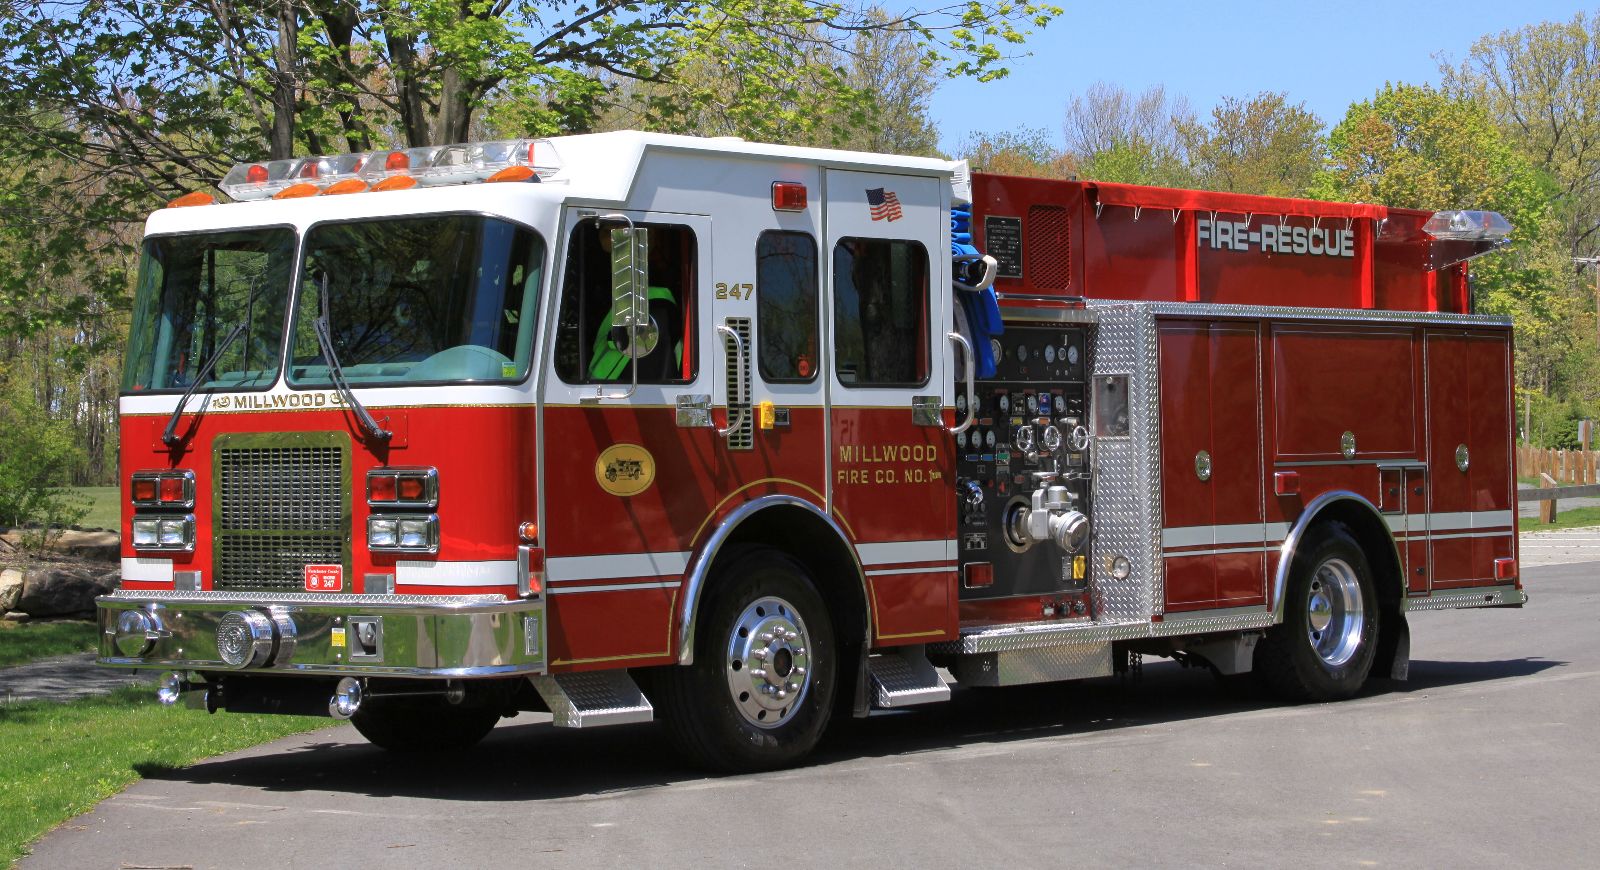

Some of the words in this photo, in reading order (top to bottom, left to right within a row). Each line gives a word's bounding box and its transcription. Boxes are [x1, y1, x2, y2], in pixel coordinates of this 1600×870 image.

[1197, 219, 1355, 257] FIRE-RESCUE
[715, 282, 754, 301] 247
[234, 393, 326, 409] MILLWOOD
[839, 445, 937, 463] MILLWOOD
[837, 469, 869, 484] FIRE
[875, 469, 899, 484] CO.
[904, 469, 927, 483] NO.
